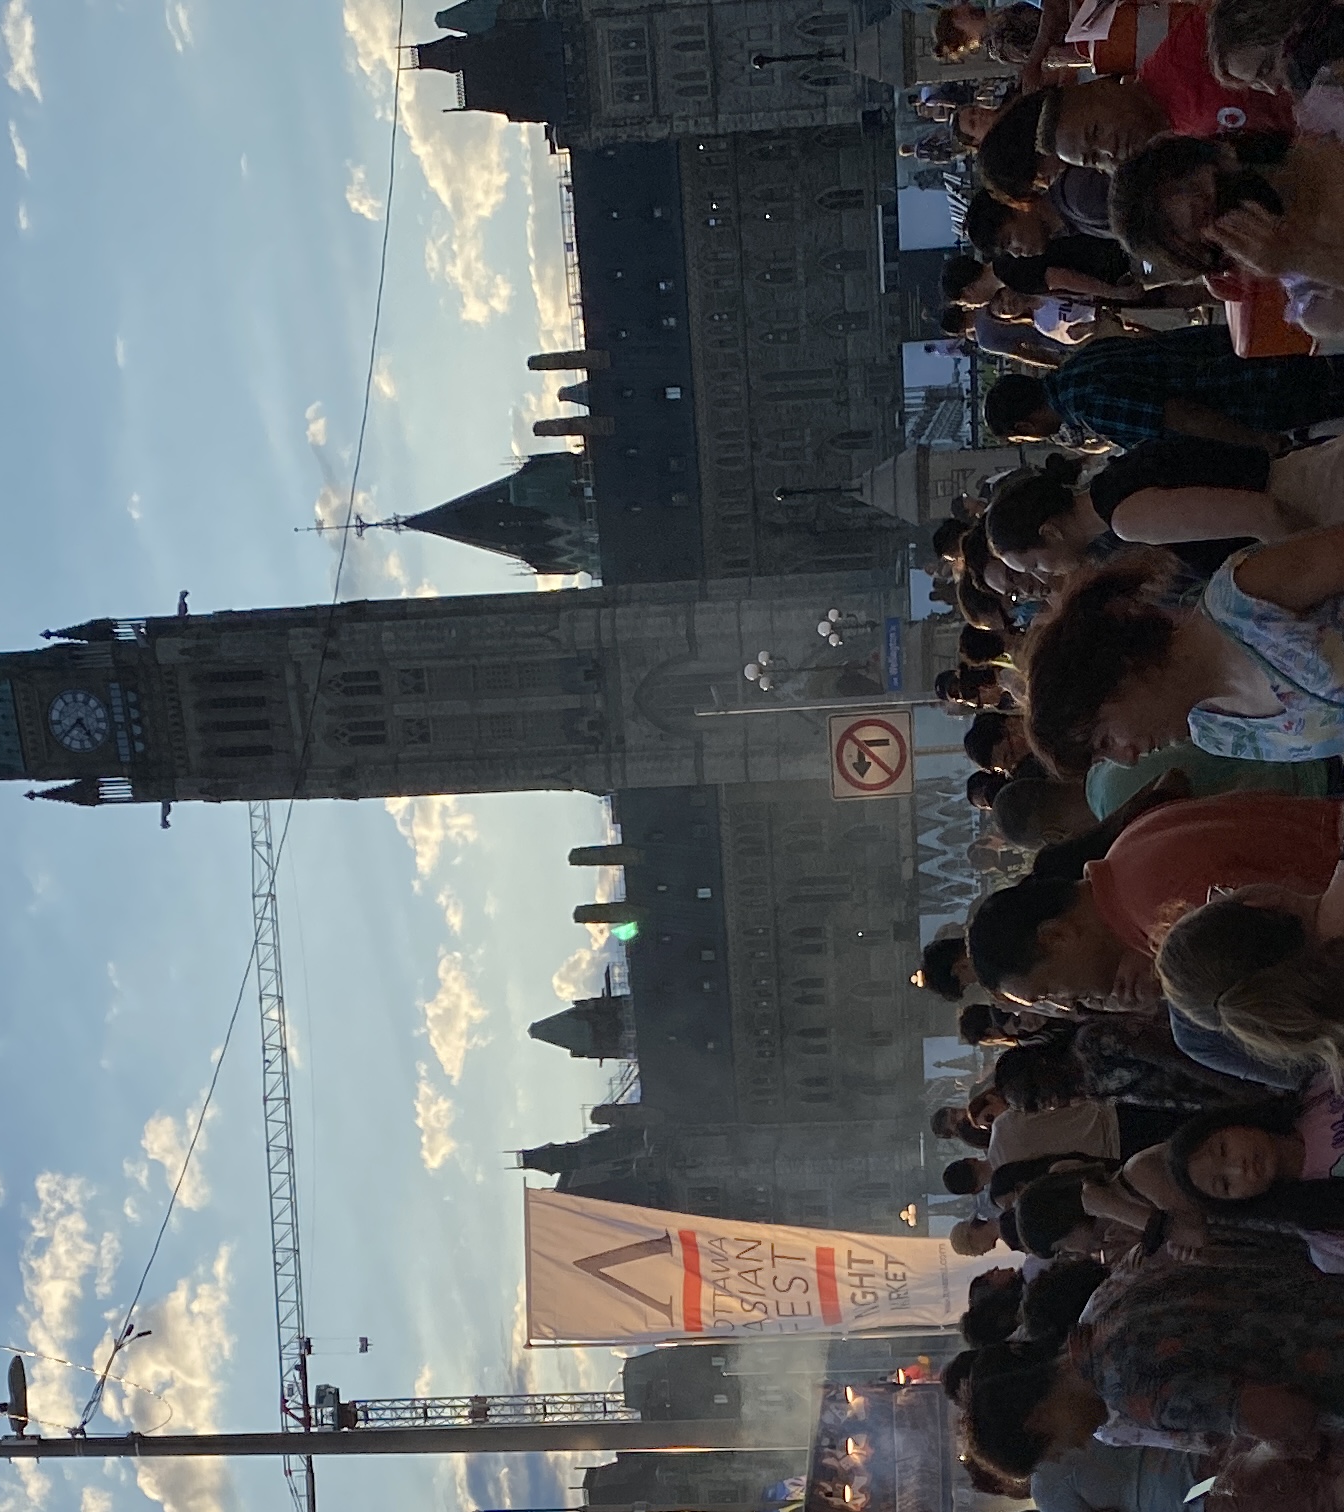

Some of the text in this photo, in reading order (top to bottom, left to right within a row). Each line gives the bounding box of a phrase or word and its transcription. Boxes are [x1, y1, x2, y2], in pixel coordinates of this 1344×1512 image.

[707, 1236, 735, 1332] OTTAWA
[733, 1237, 770, 1332] ASIAN
[770, 1243, 813, 1333] FEST
[846, 1249, 880, 1319] NGHT
[884, 1253, 911, 1311] MRKET
